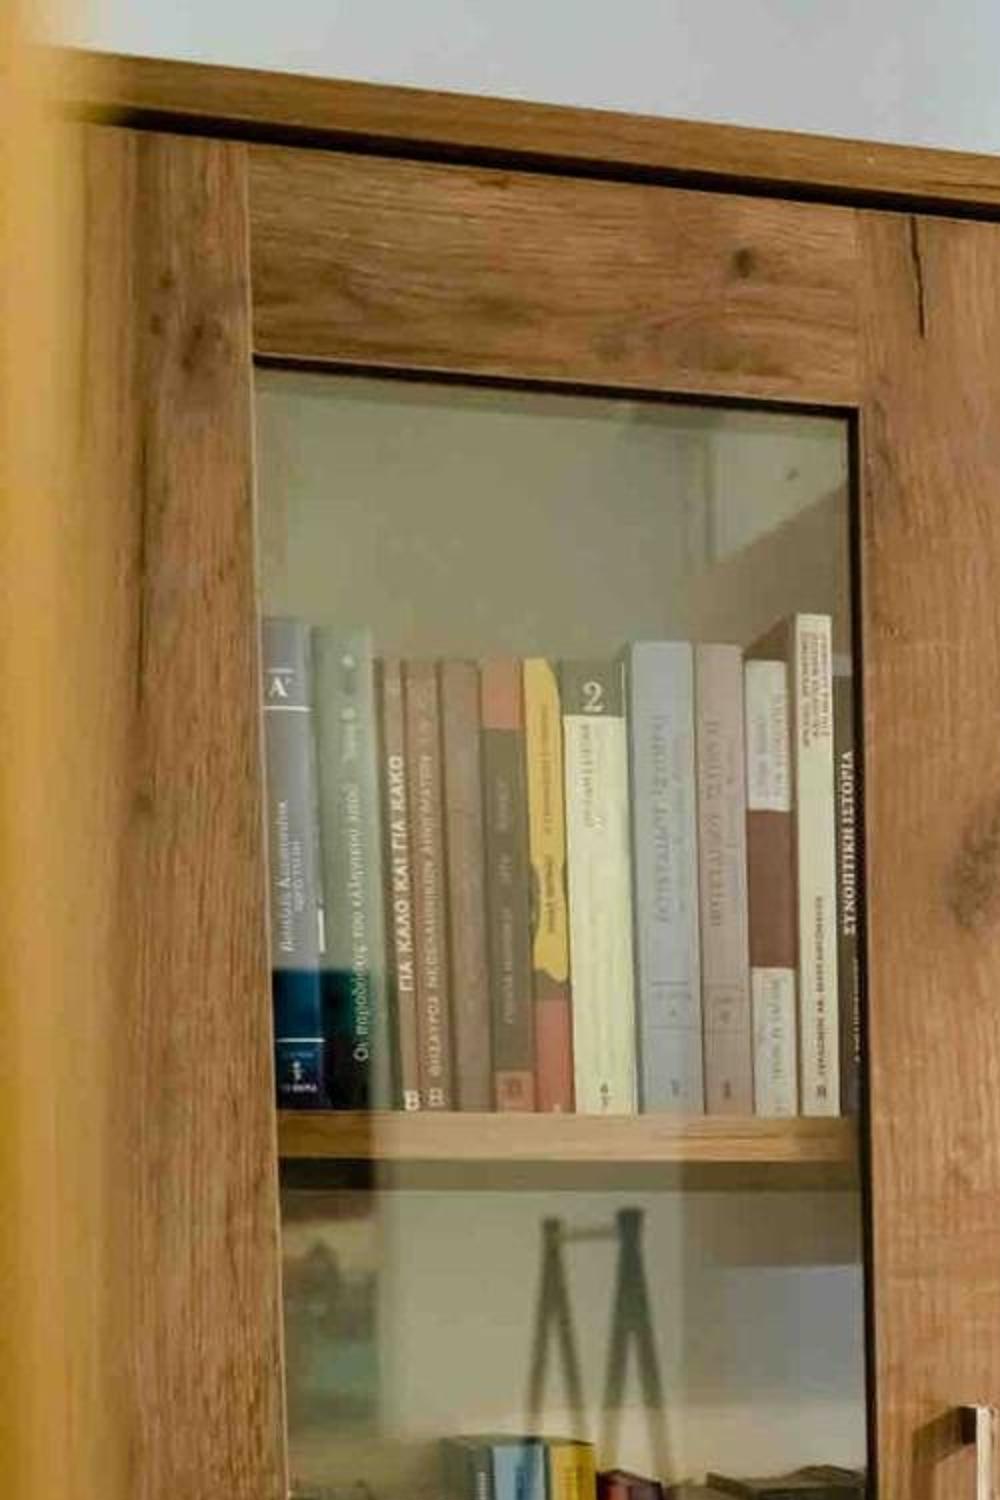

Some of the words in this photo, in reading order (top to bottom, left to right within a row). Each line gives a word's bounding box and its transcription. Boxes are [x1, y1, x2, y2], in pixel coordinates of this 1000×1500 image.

[582, 684, 604, 713] 2
[388, 755, 406, 812] ΚΑΚΟ
[839, 751, 854, 824] ΙΣΤΟΡΙΑ
[391, 820, 408, 851] ΓΙΑ
[392, 856, 410, 892] ΚΑΙ
[841, 827, 857, 936] ΣΥΝΟΠΤΙΚΗ
[395, 900, 412, 953] ΚΑΛΟ
[399, 961, 415, 992] ΓΙΑ
